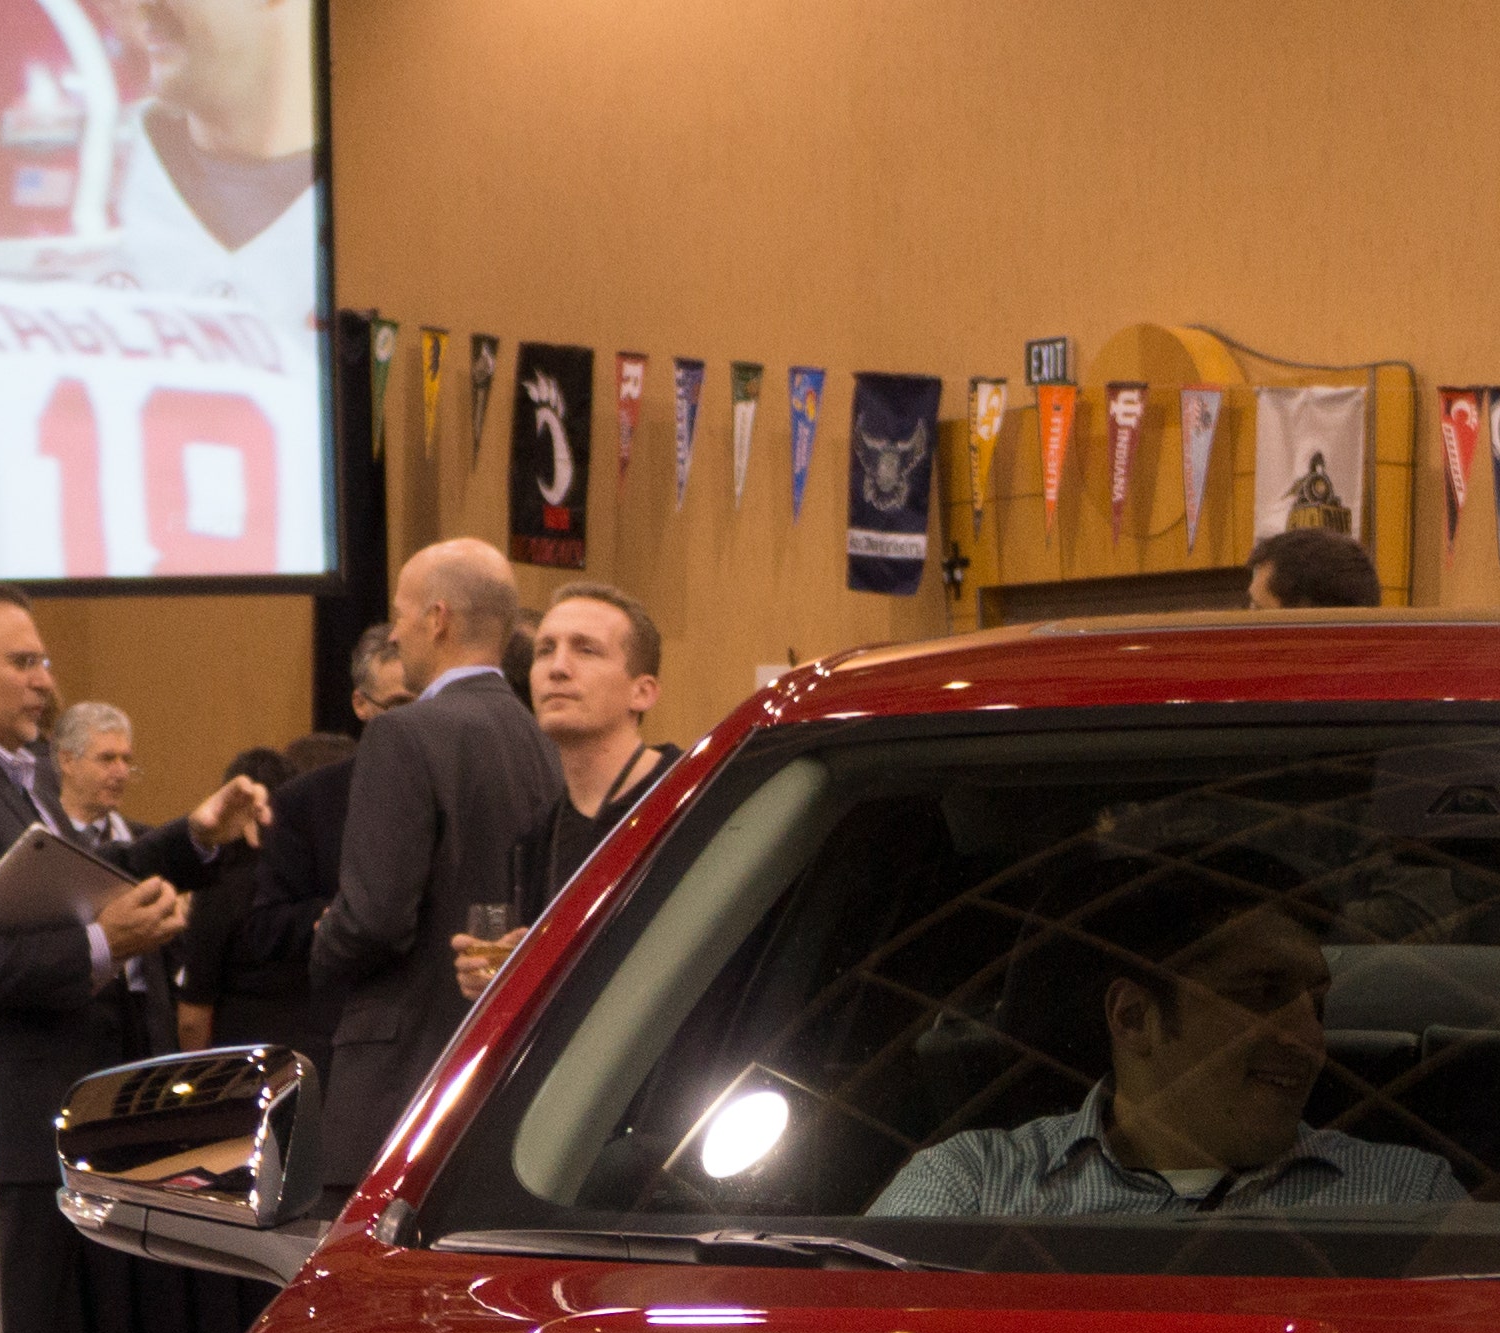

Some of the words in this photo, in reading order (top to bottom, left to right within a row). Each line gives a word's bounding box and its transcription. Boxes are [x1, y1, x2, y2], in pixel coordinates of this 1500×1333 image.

[620, 362, 644, 399] R
[1031, 342, 1064, 383] EXIT
[38, 376, 280, 577] 10
[1112, 428, 1130, 502] INDIANA
